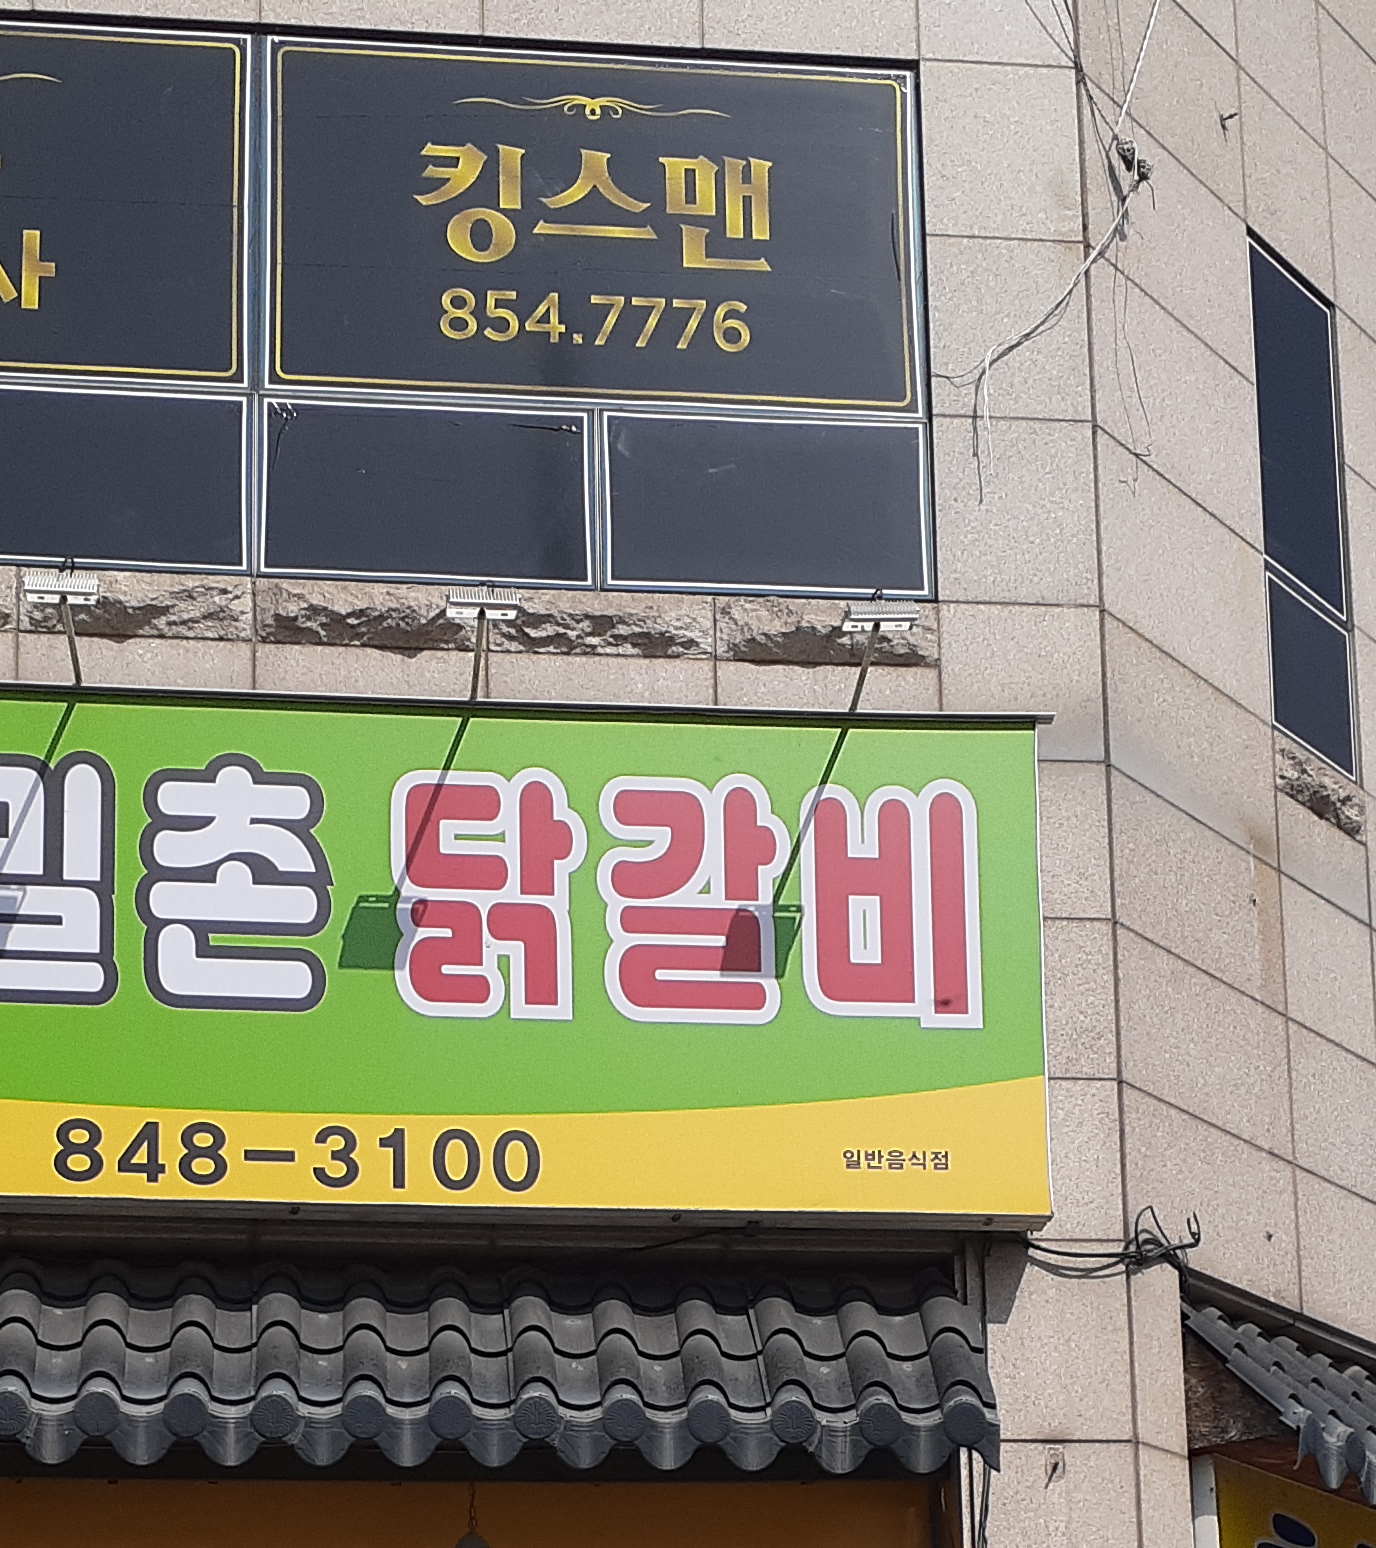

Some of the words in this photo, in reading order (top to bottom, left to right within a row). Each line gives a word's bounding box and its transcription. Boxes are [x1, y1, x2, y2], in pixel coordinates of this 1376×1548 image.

[414, 140, 773, 273] 킹스맨
[439, 287, 752, 354] 854.7776
[391, 767, 984, 1030] 닭갈비
[52, 1117, 542, 1193] 848-3100
[841, 1146, 951, 1173] 일반음식점
